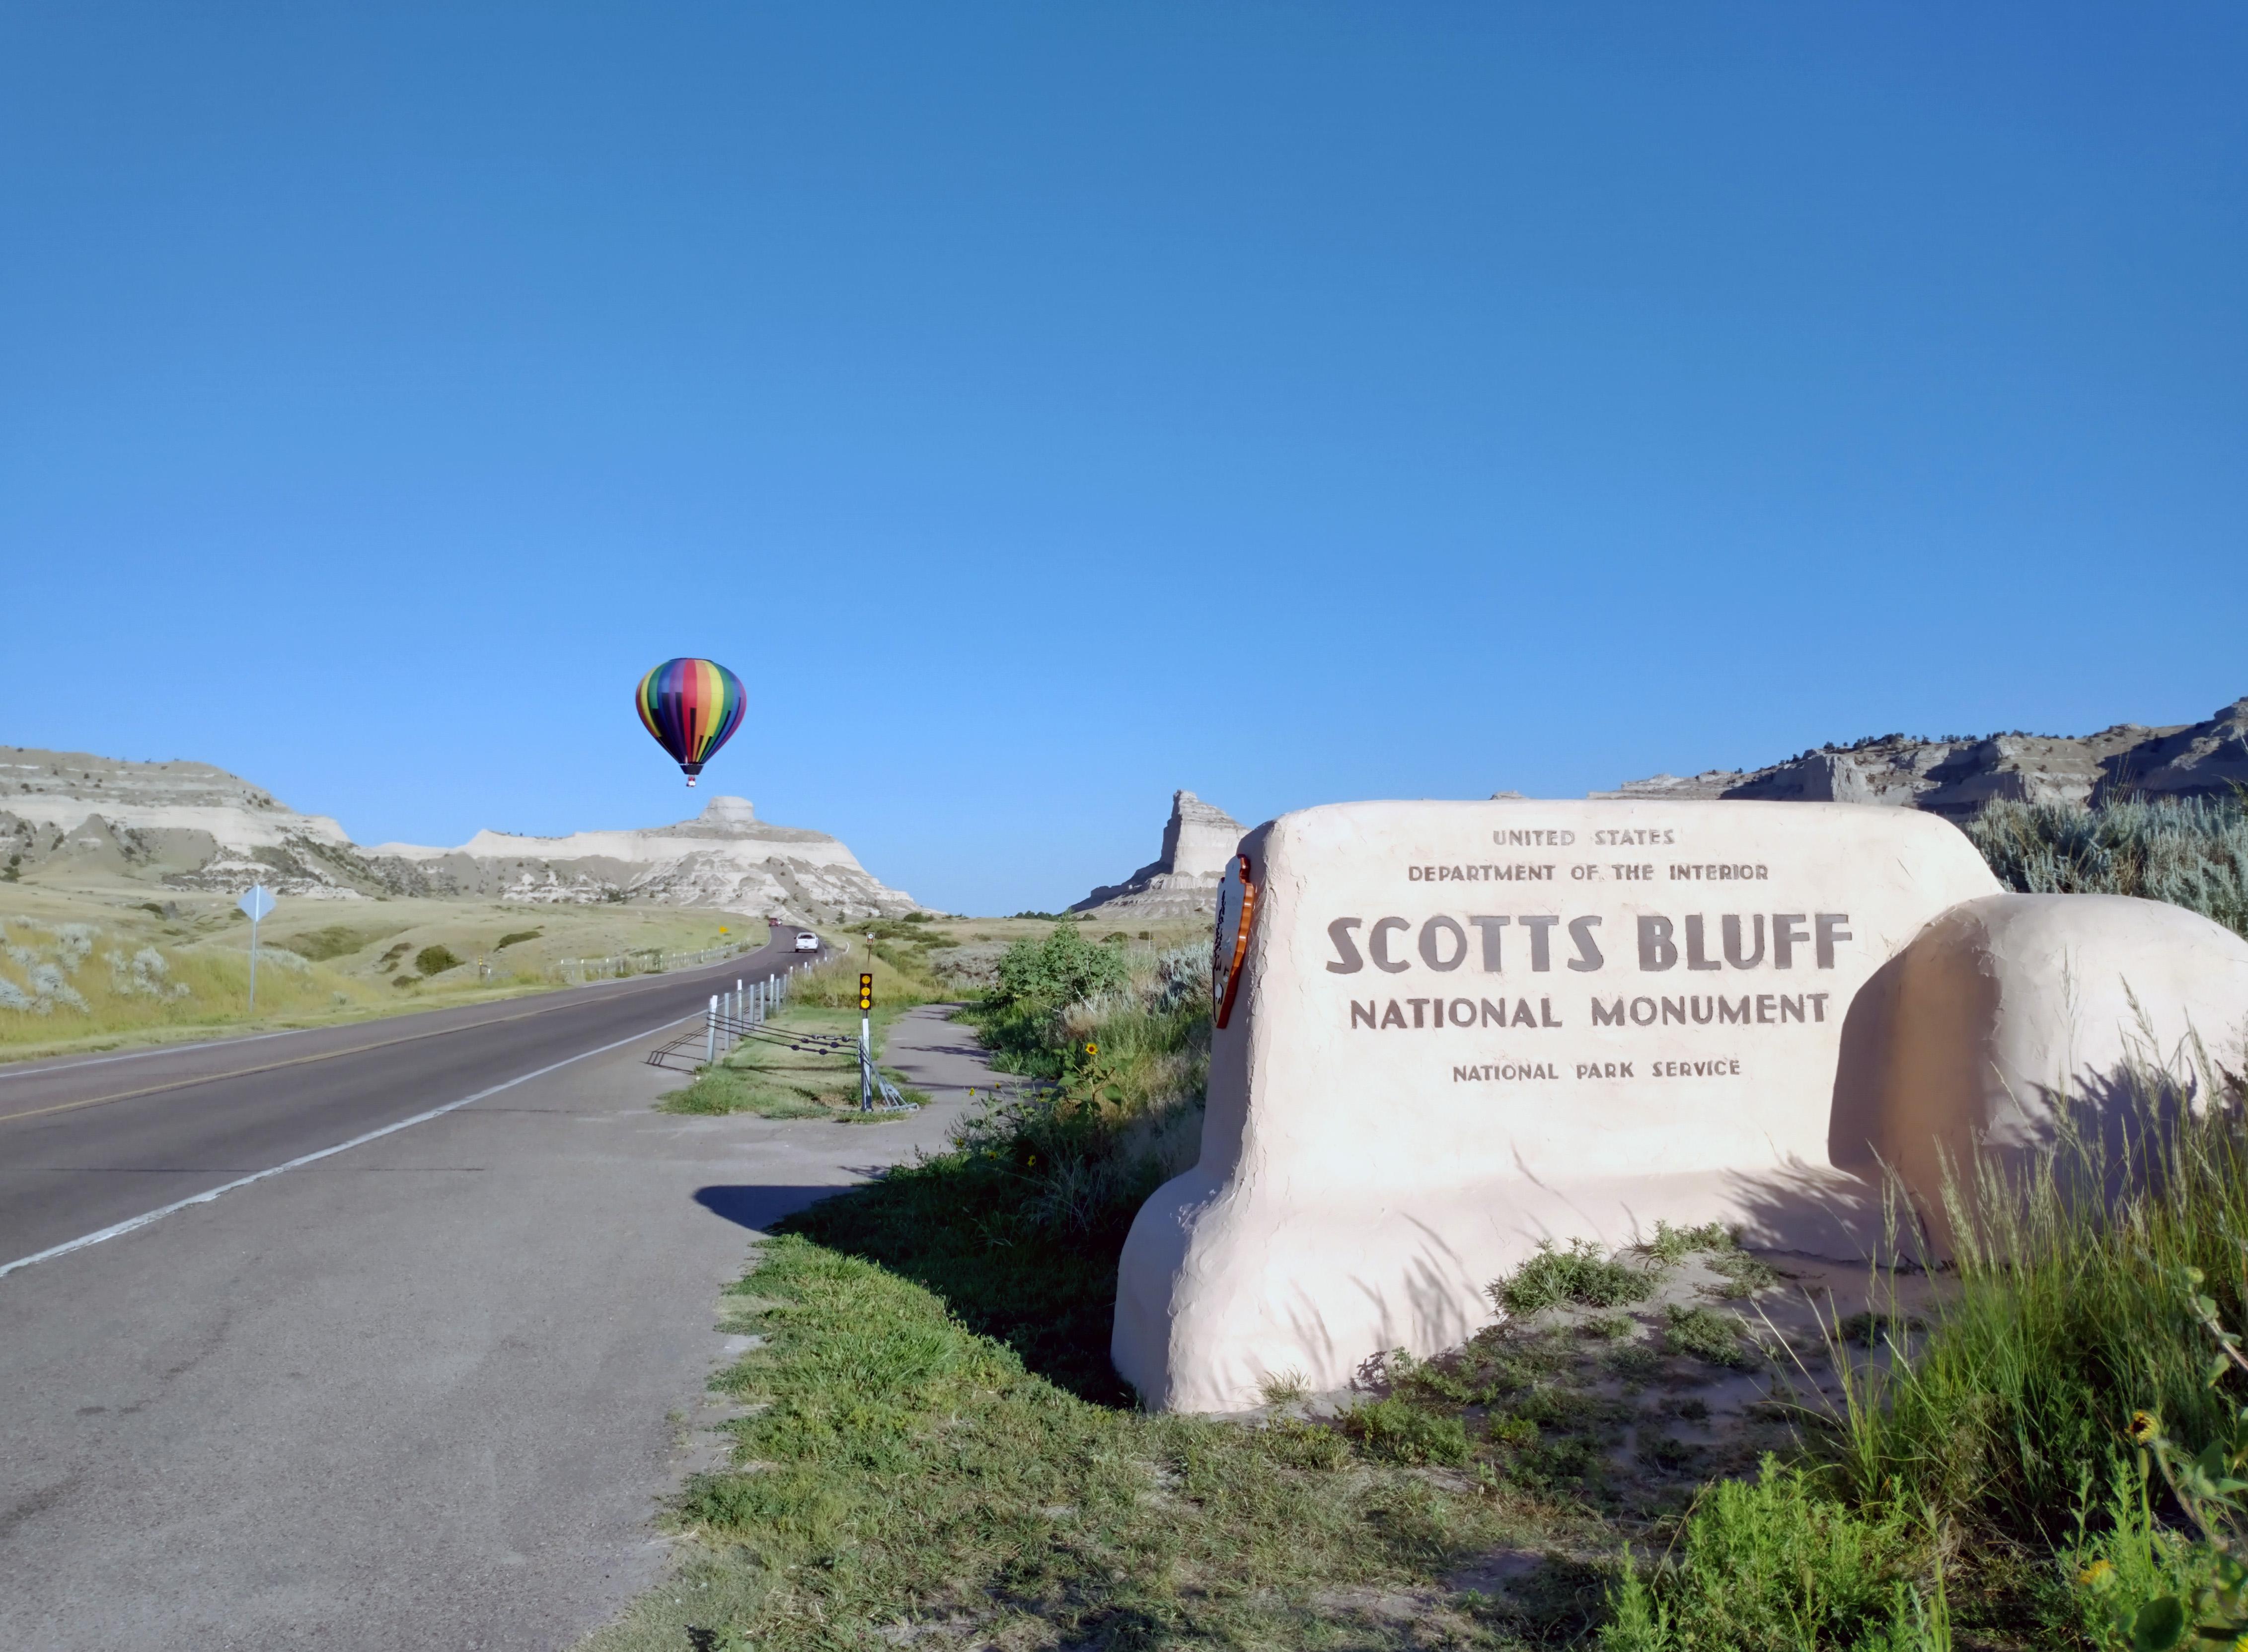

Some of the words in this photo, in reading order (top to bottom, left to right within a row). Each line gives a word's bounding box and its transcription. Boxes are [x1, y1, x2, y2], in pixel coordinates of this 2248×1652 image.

[1494, 830, 1575, 846] UNITED
[1595, 829, 1675, 845] STATES
[1409, 864, 1556, 881] DEPARTMENT
[1571, 864, 1598, 880] OF
[1611, 864, 1654, 881] THE
[1670, 864, 1768, 880] INTERIOR
[1326, 914, 1604, 975] SCOTTS
[1637, 912, 1852, 972] BLUFF
[1351, 998, 1562, 1030] NATIONAL
[1591, 993, 1829, 1026] MONUMENT
[1453, 1063, 1559, 1082] NATIONAL
[1576, 1062, 1634, 1079] PARK
[1652, 1060, 1739, 1077] SERVICE
